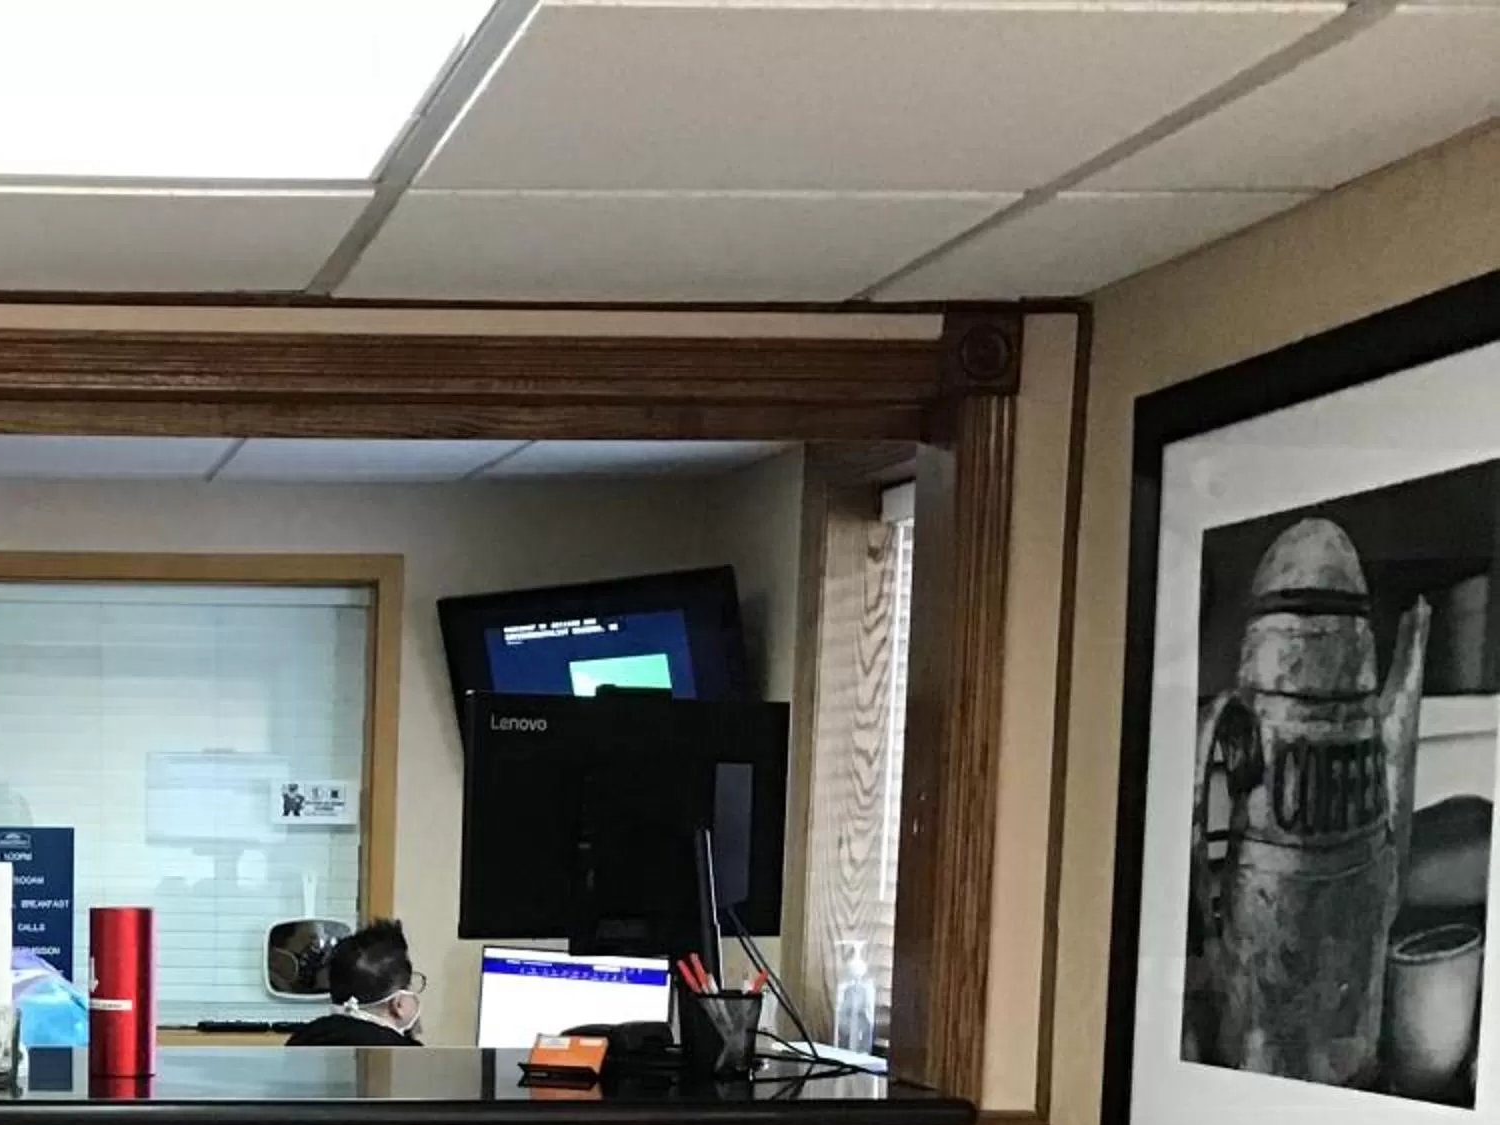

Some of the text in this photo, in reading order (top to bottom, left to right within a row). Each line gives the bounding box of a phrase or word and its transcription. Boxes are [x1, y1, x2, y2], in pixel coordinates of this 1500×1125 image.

[490, 712, 548, 731] Lenovo
[20, 898, 69, 909] BREAKFAST
[17, 922, 47, 933] CALLS
